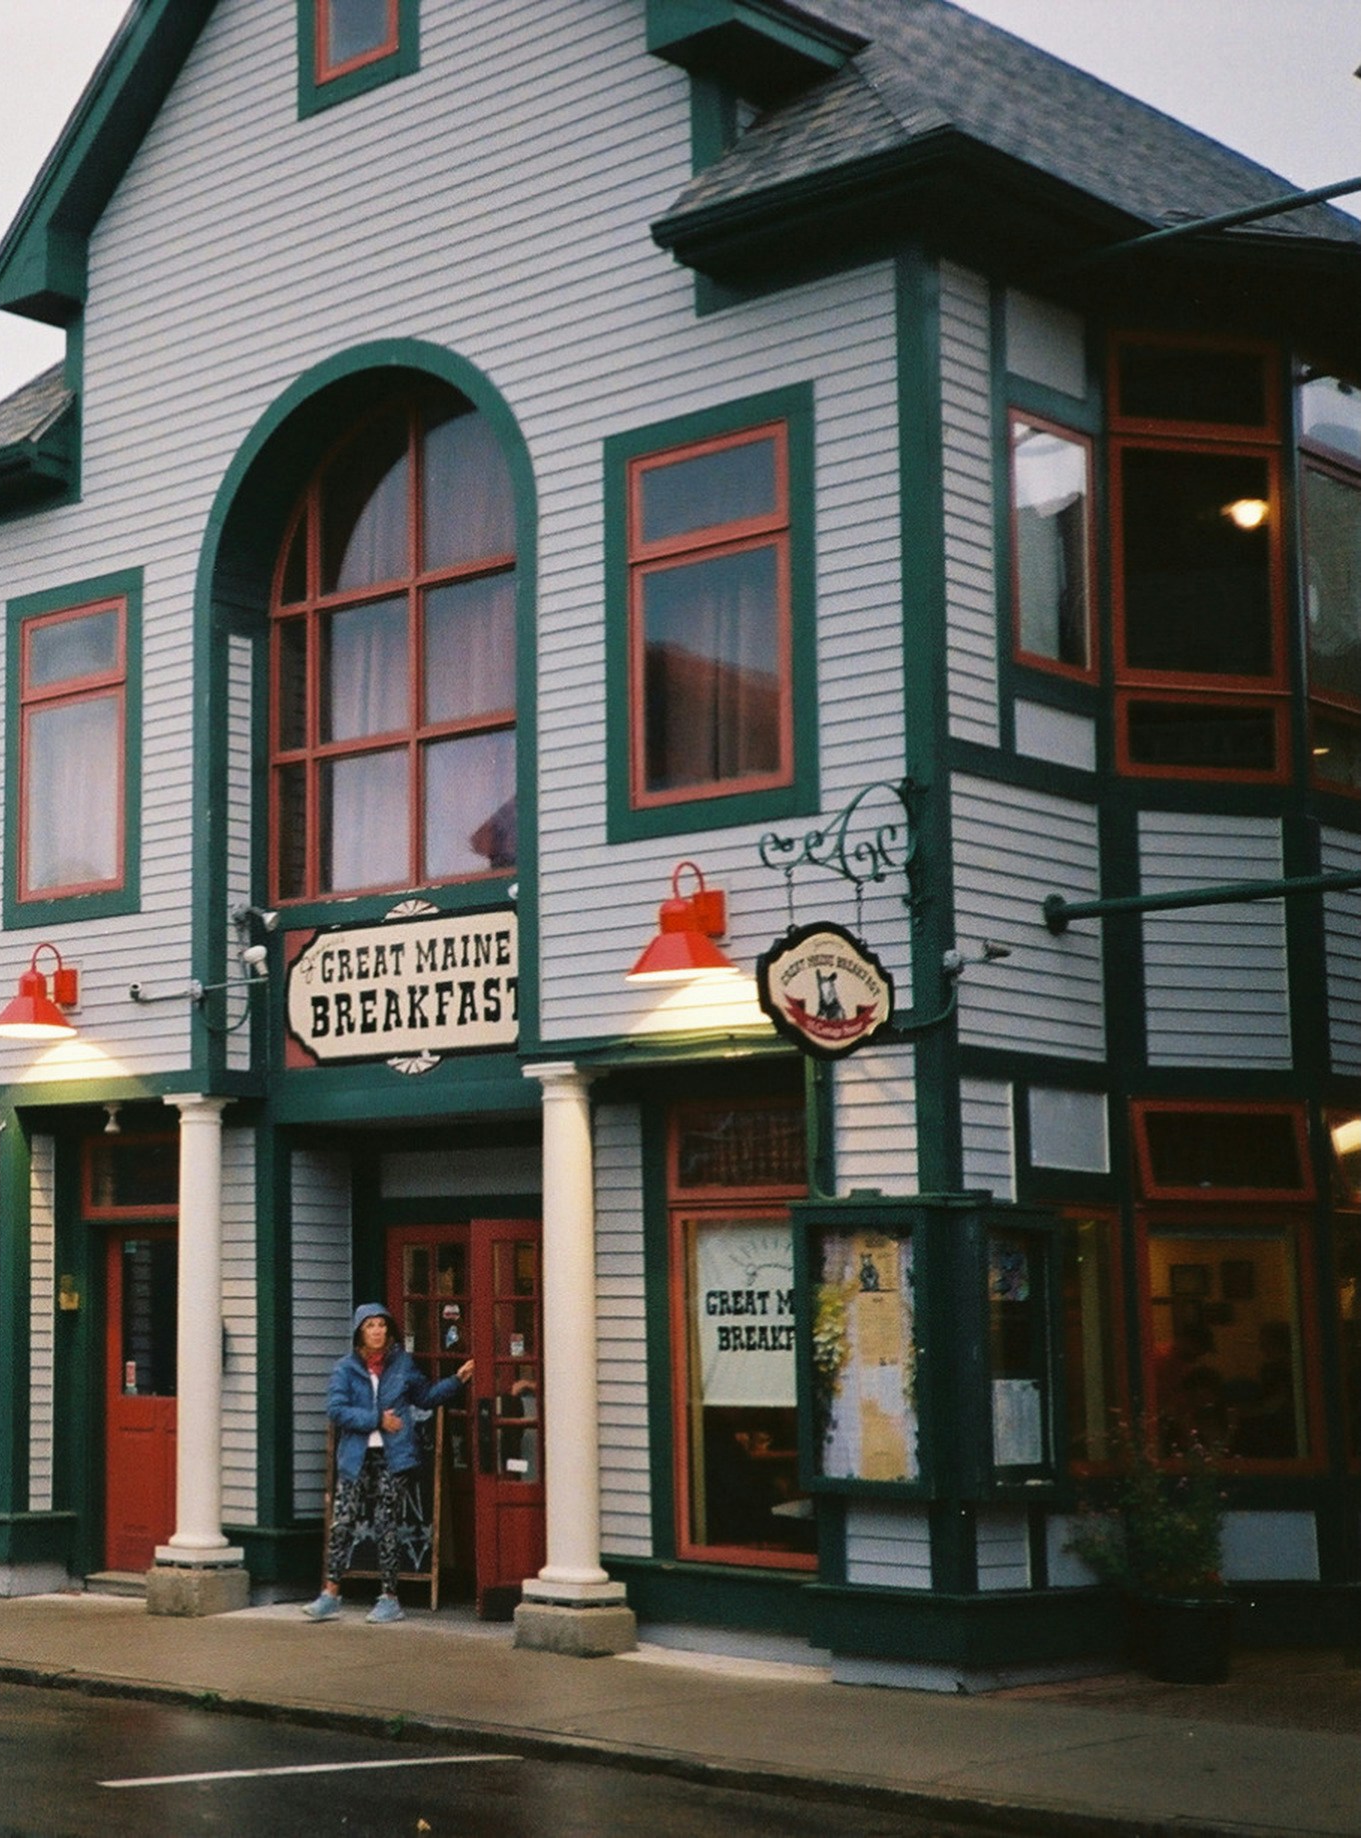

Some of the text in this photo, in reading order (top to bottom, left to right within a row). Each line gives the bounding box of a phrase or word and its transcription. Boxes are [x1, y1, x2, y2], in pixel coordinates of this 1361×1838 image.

[321, 942, 405, 984] GREAT
[416, 930, 511, 973] MAINE
[311, 976, 519, 1038] BREAKFAST
[705, 1289, 770, 1316] GREAT
